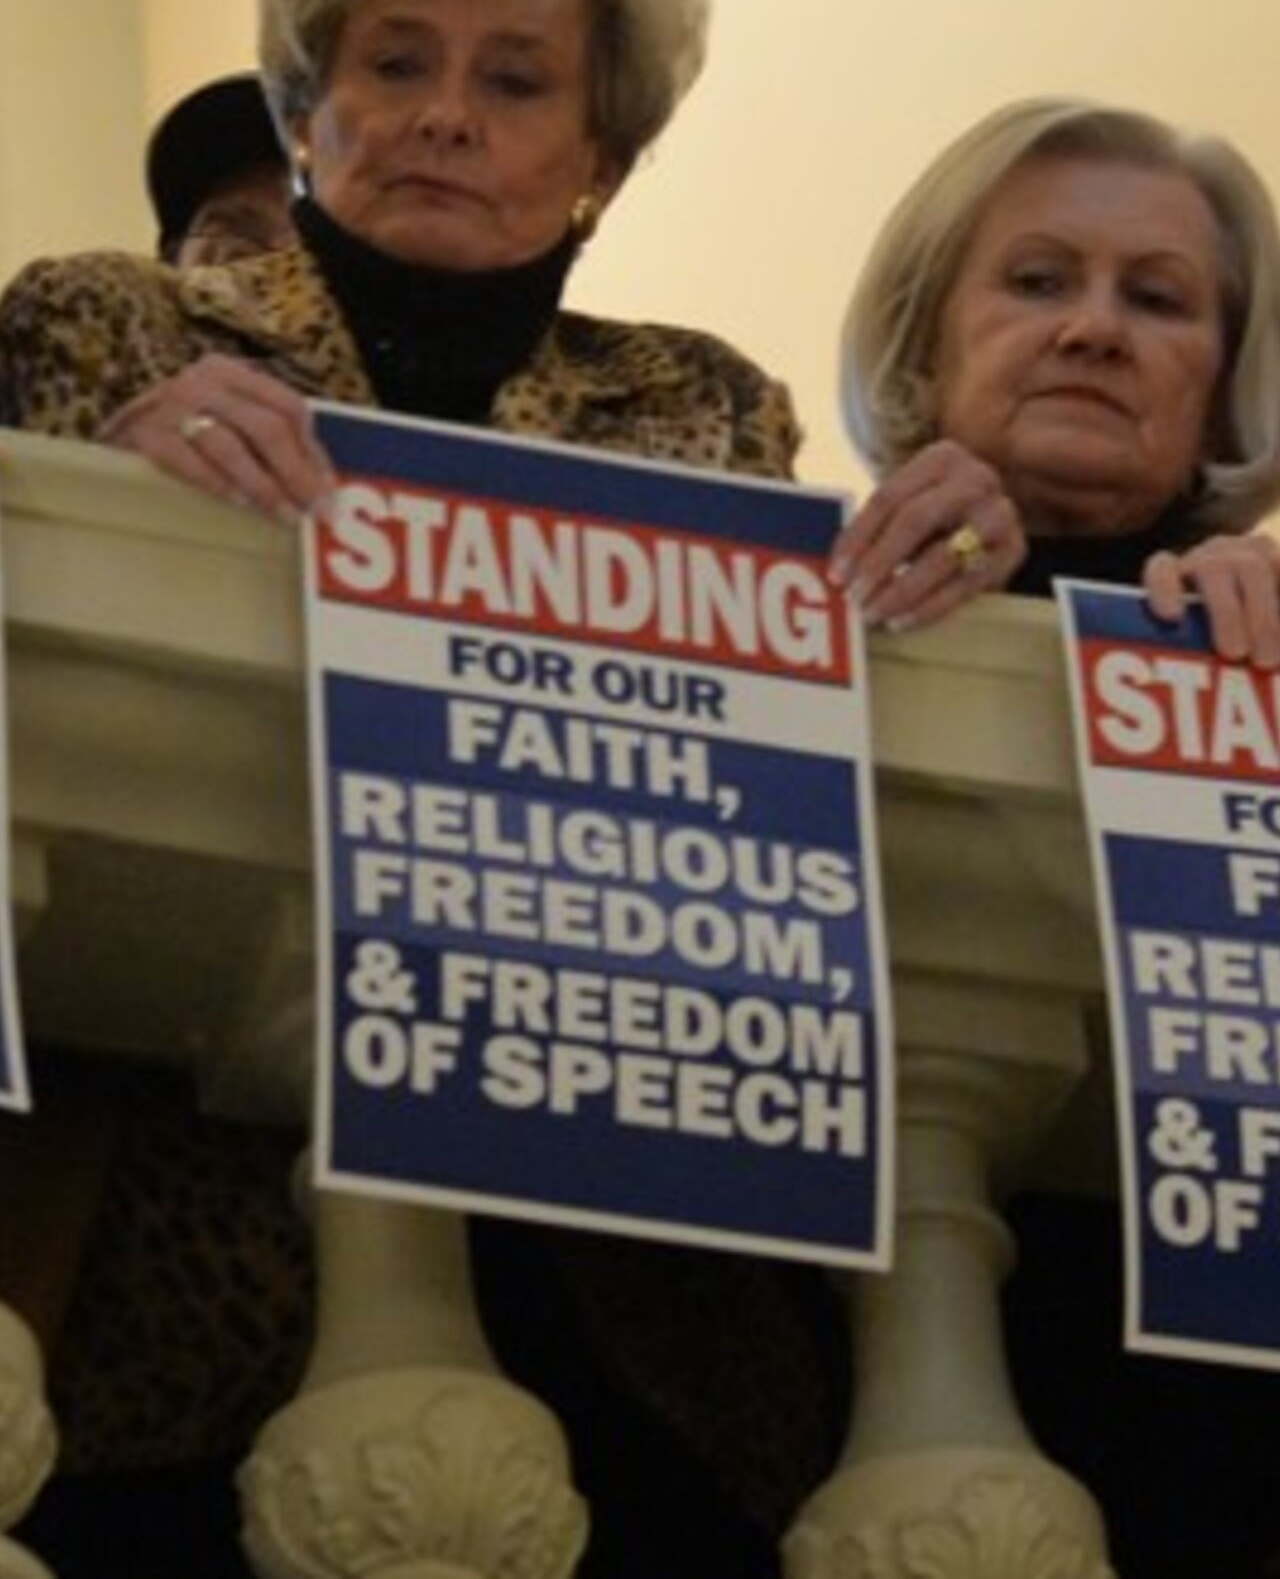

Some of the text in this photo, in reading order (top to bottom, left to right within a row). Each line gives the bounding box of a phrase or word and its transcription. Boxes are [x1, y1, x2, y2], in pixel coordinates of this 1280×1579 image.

[327, 485, 834, 669] STANDING
[448, 635, 728, 721] FOR OUR
[446, 699, 739, 820] FAITH,
[338, 773, 859, 916] RELIGIOUS
[353, 853, 854, 1001] FREEDOM,
[346, 940, 864, 1080] & FREEDOM
[344, 1017, 867, 1159] OF SPEECH
[1148, 1097, 1217, 1172] &
[1148, 1175, 1264, 1253] OF
